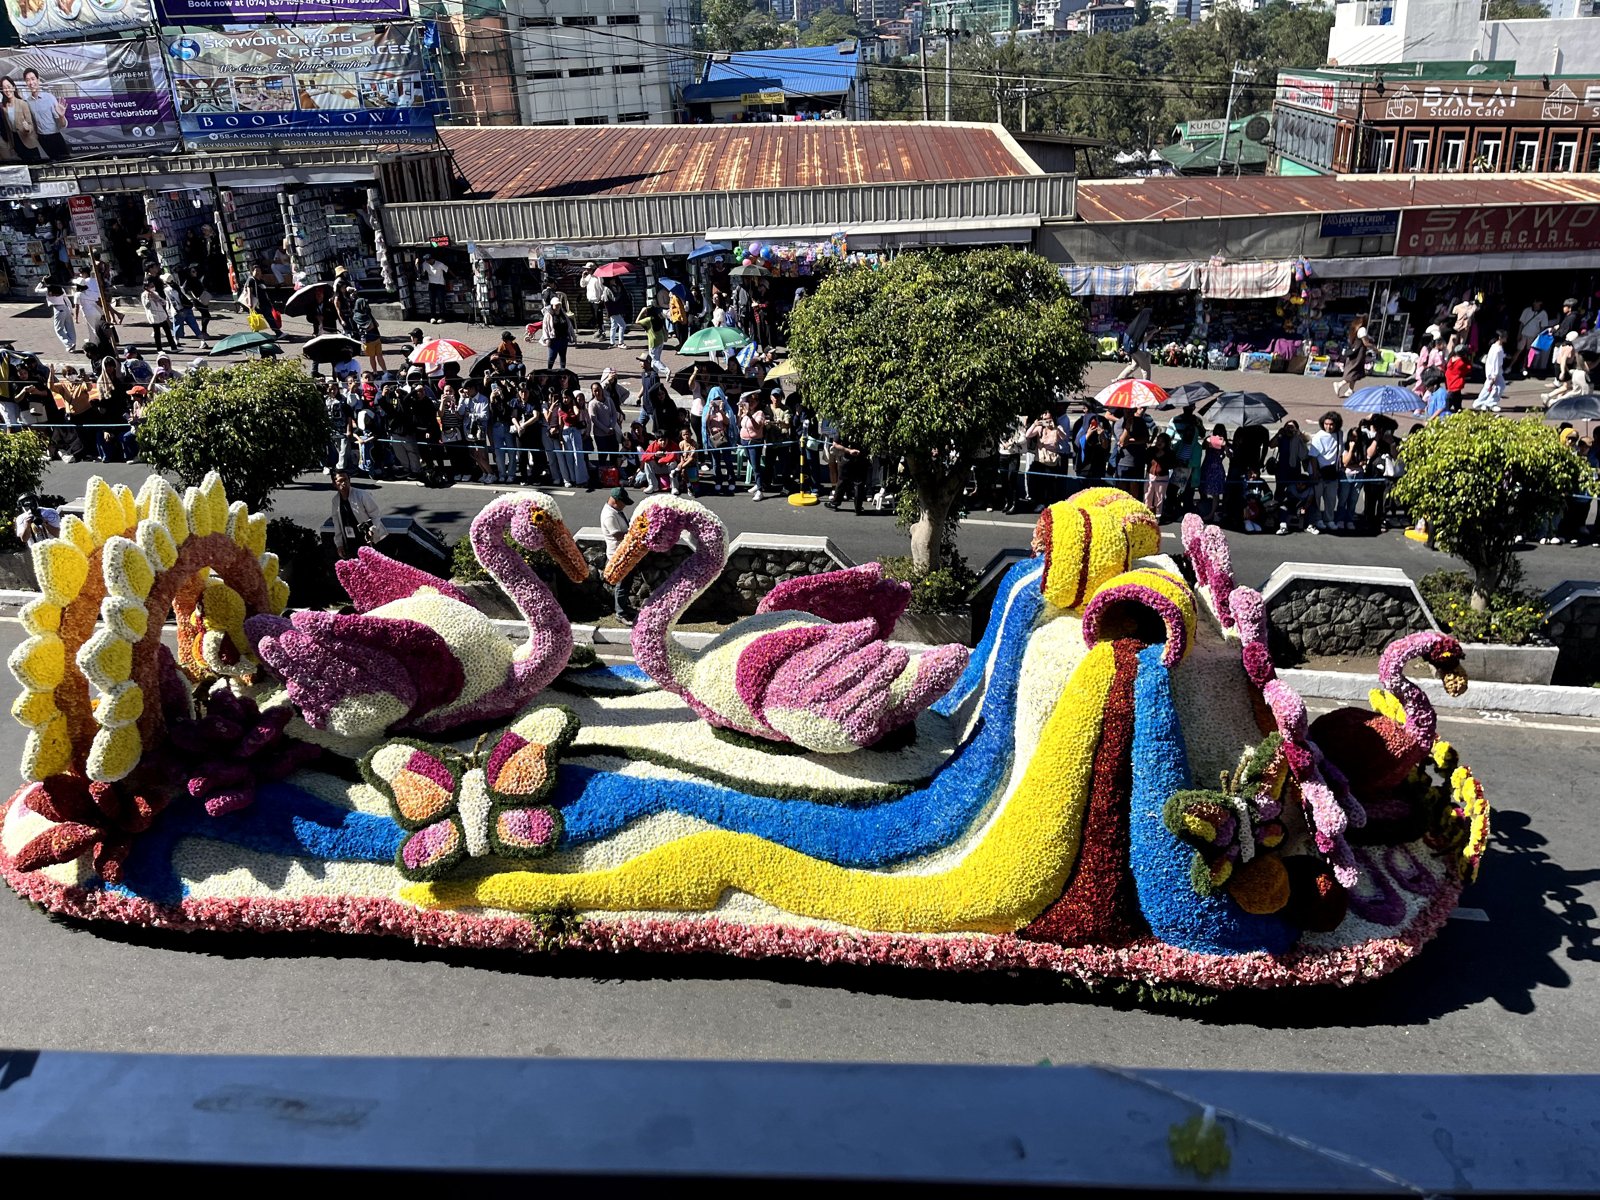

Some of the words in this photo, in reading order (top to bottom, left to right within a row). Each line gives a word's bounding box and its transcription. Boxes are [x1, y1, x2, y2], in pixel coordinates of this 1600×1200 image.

[188, 0, 212, 8] Book
[204, 35, 299, 49] SKYWORLD
[304, 33, 362, 44] HOTEL
[276, 48, 293, 58] &
[299, 45, 411, 58] RESIDENCES
[238, 63, 266, 72] Care
[271, 62, 289, 71] For
[294, 61, 321, 72] Your
[325, 60, 371, 70] Comfort
[112, 71, 149, 79] SUPREME
[1422, 86, 1518, 107] BALAI
[70, 102, 107, 111] SUPREME
[108, 101, 137, 109] Venues
[1430, 107, 1472, 117] Studio
[1475, 107, 1505, 117] Cafe
[73, 111, 110, 121] SUPREME
[111, 108, 159, 118] Celebrations
[203, 115, 290, 127] BOOK
[240, 133, 265, 141] Camp
[334, 130, 363, 138] Baguio
[365, 129, 383, 137] City
[1421, 206, 1600, 232] SKYWO
[1409, 229, 1574, 248] COMMERCIAL
